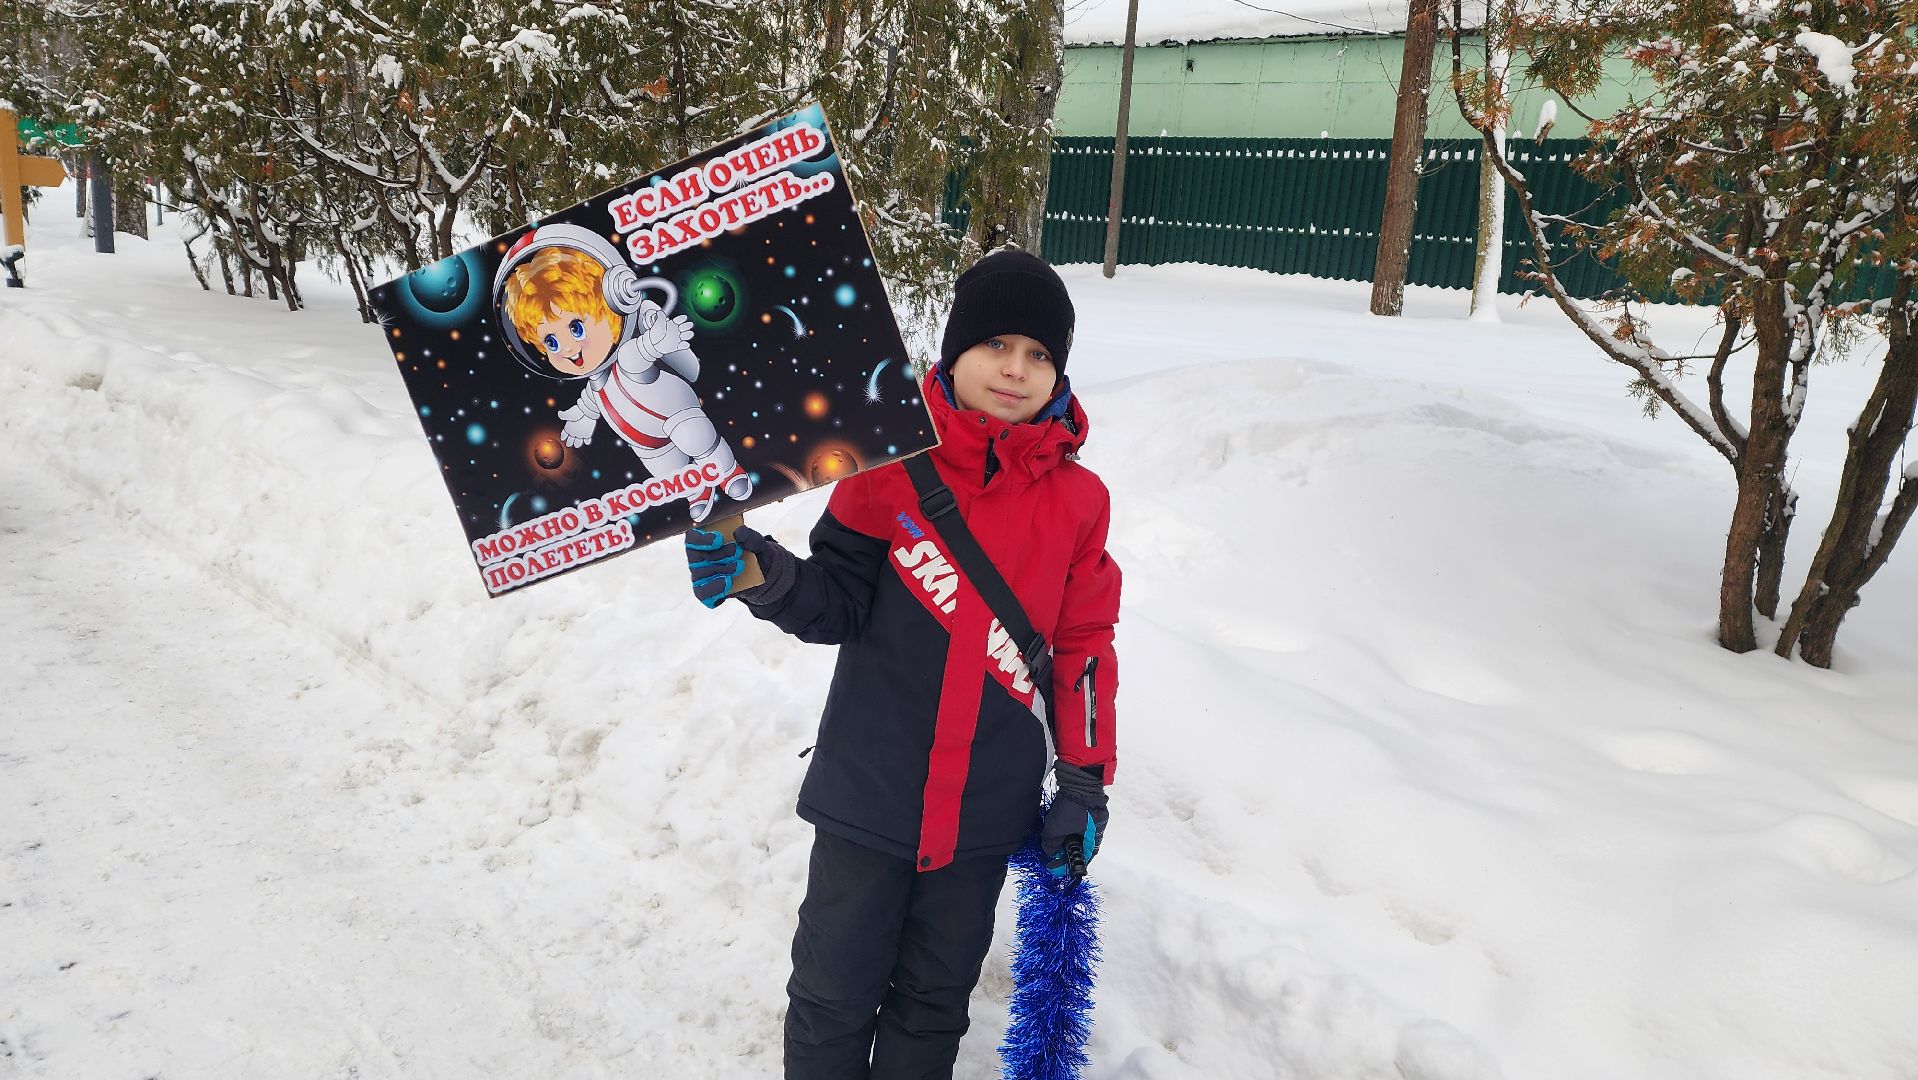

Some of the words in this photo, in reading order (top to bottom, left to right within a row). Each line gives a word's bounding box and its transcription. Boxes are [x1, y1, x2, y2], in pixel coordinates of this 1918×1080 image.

[613, 172, 704, 228] ЕСЛИ
[708, 127, 821, 188] ОЧЕНЬ
[631, 176, 830, 260] ЗАХОТЕТЬ...
[475, 512, 580, 562] МОЖНО
[583, 504, 605, 525] В
[606, 462, 721, 516] КОСМОС
[487, 524, 632, 588] ПОЛЕТЕТЬ!
